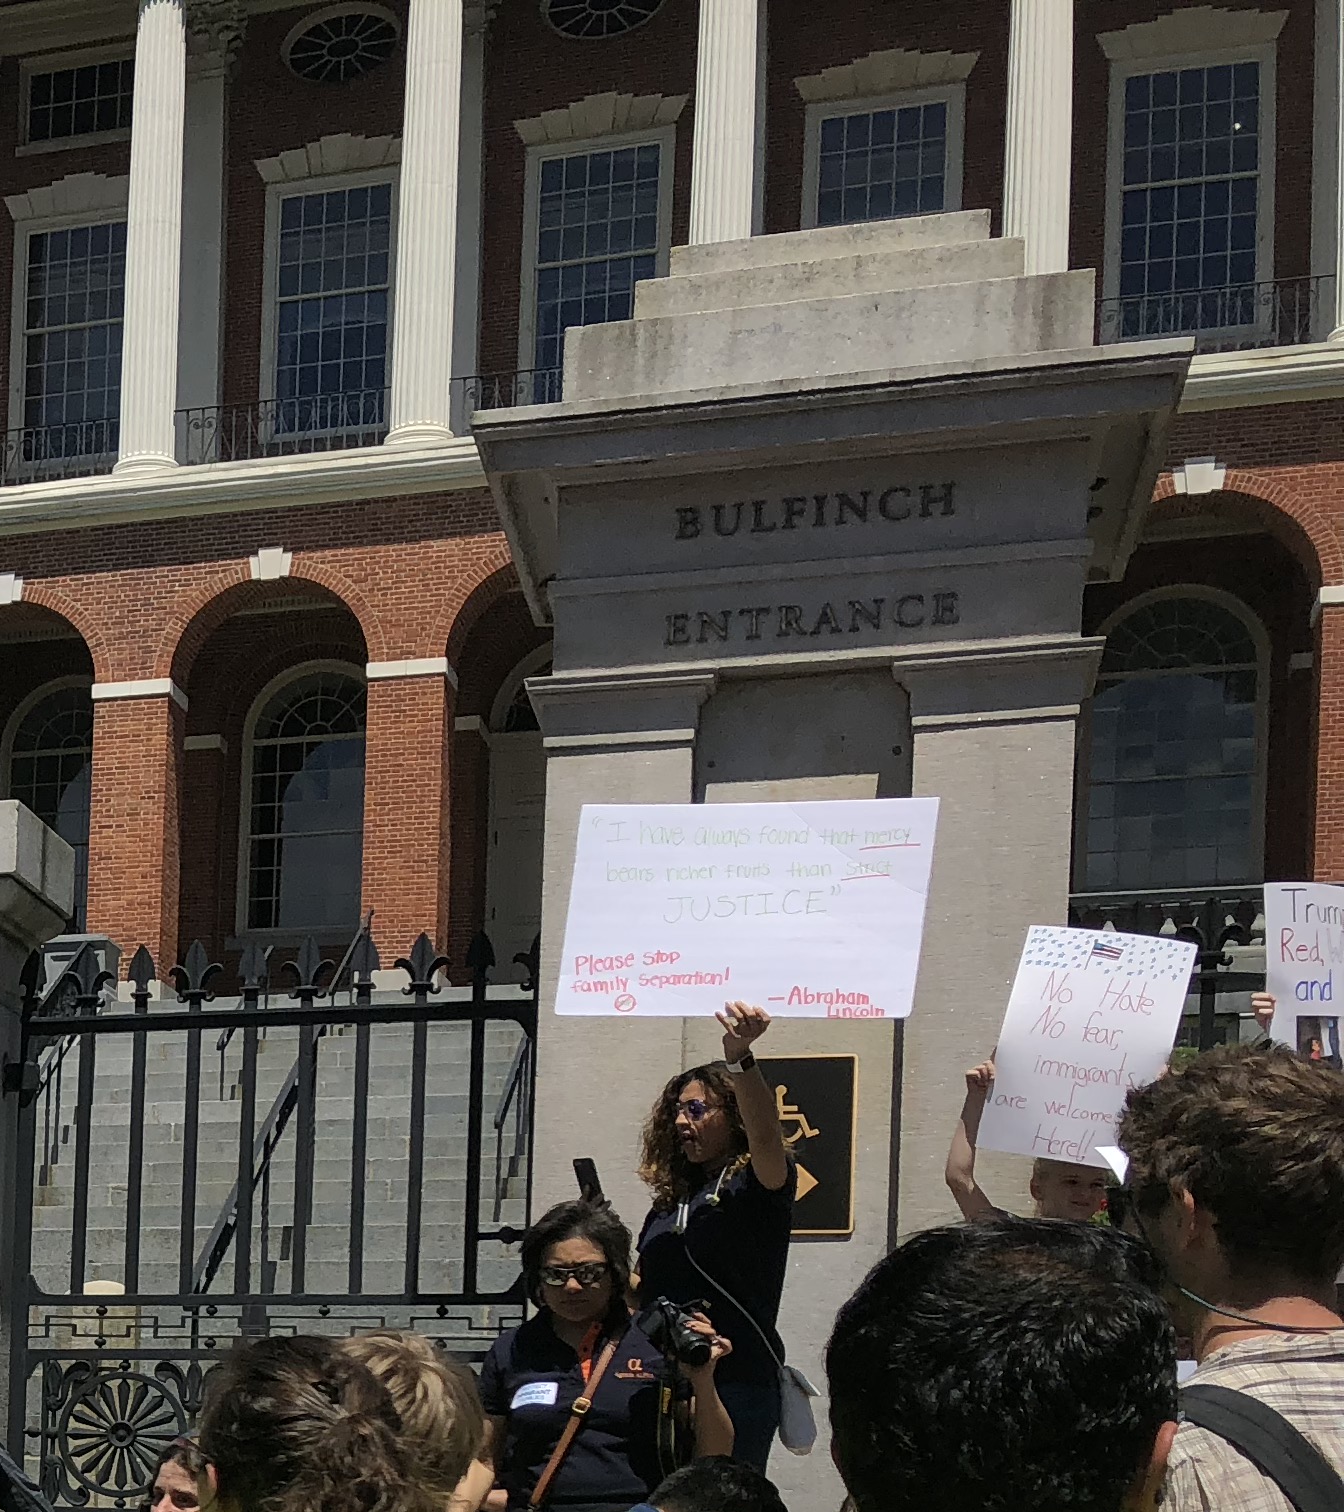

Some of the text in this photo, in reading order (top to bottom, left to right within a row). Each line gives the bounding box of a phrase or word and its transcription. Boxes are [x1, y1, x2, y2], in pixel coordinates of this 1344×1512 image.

[675, 480, 957, 540] BULFINCH
[663, 591, 961, 647] ENTRANCE
[639, 820, 686, 846] have
[694, 825, 751, 847] always
[759, 825, 810, 846] found
[818, 827, 860, 846] that
[864, 826, 912, 845] mercy
[606, 861, 655, 883] bears
[666, 864, 718, 883] richer
[786, 860, 833, 878] than
[1280, 887, 1344, 934] Trum
[574, 952, 635, 976] Please
[570, 975, 630, 993] family
[1040, 970, 1155, 1016] No Hate
[1295, 968, 1333, 1002] and
[826, 1003, 886, 1019] Lincoln
[1030, 1004, 1067, 1039] No
[1033, 1052, 1136, 1090] immigrants
[995, 1093, 1028, 1110] are
